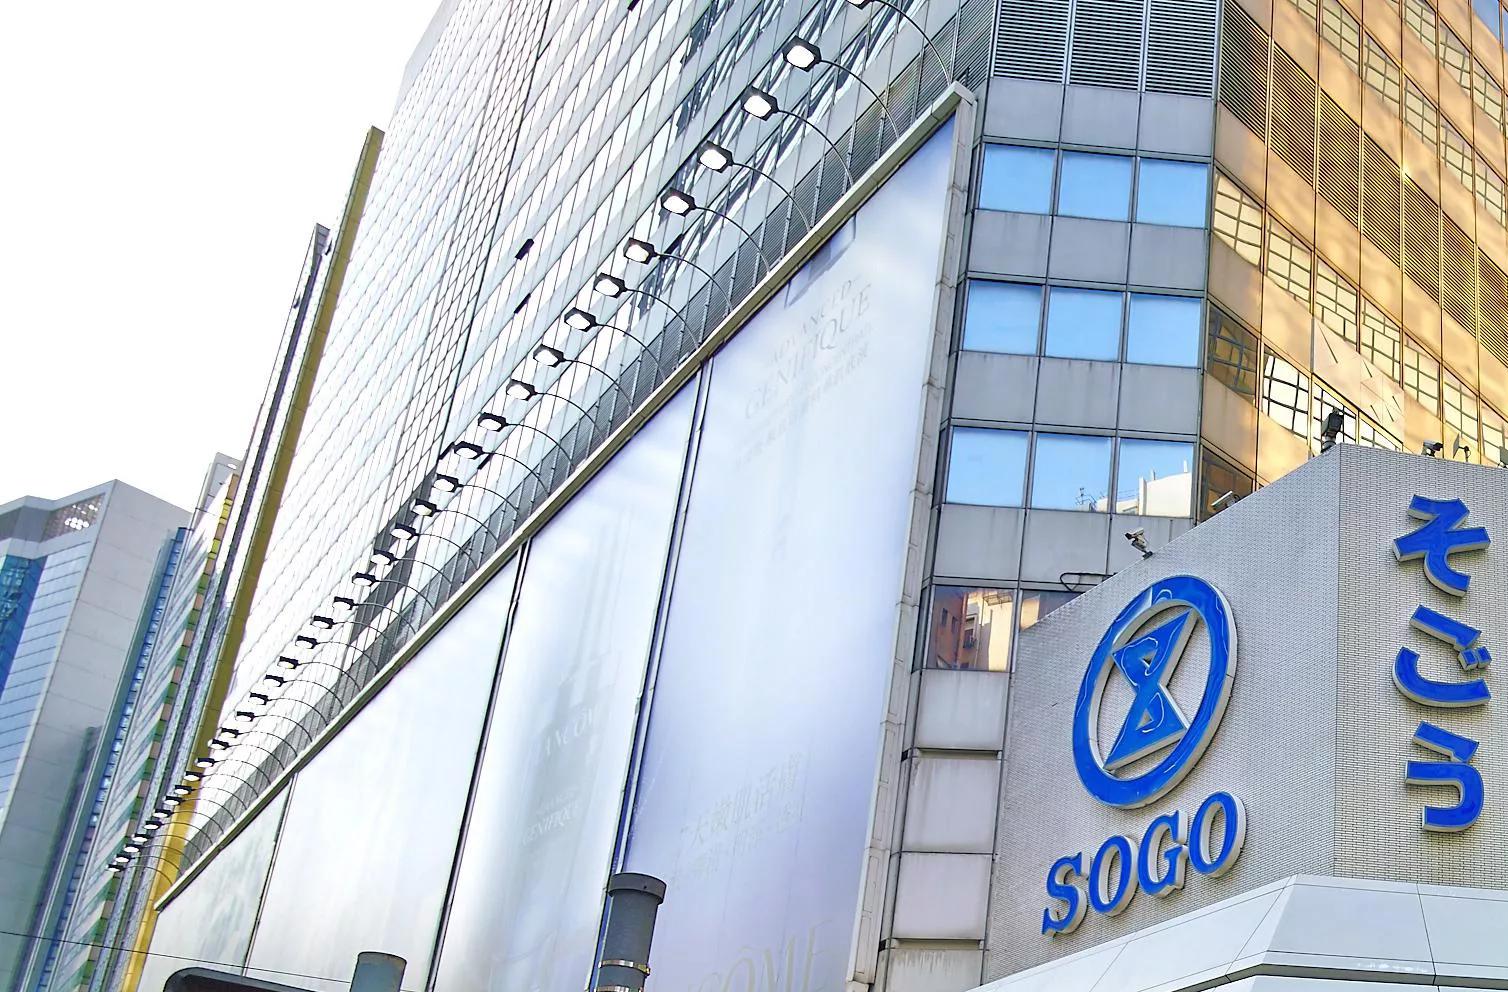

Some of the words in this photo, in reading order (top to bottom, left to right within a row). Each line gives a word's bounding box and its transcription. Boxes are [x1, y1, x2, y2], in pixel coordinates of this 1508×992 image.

[1392, 494, 1493, 833] そごう
[1041, 790, 1247, 940] SOGO
